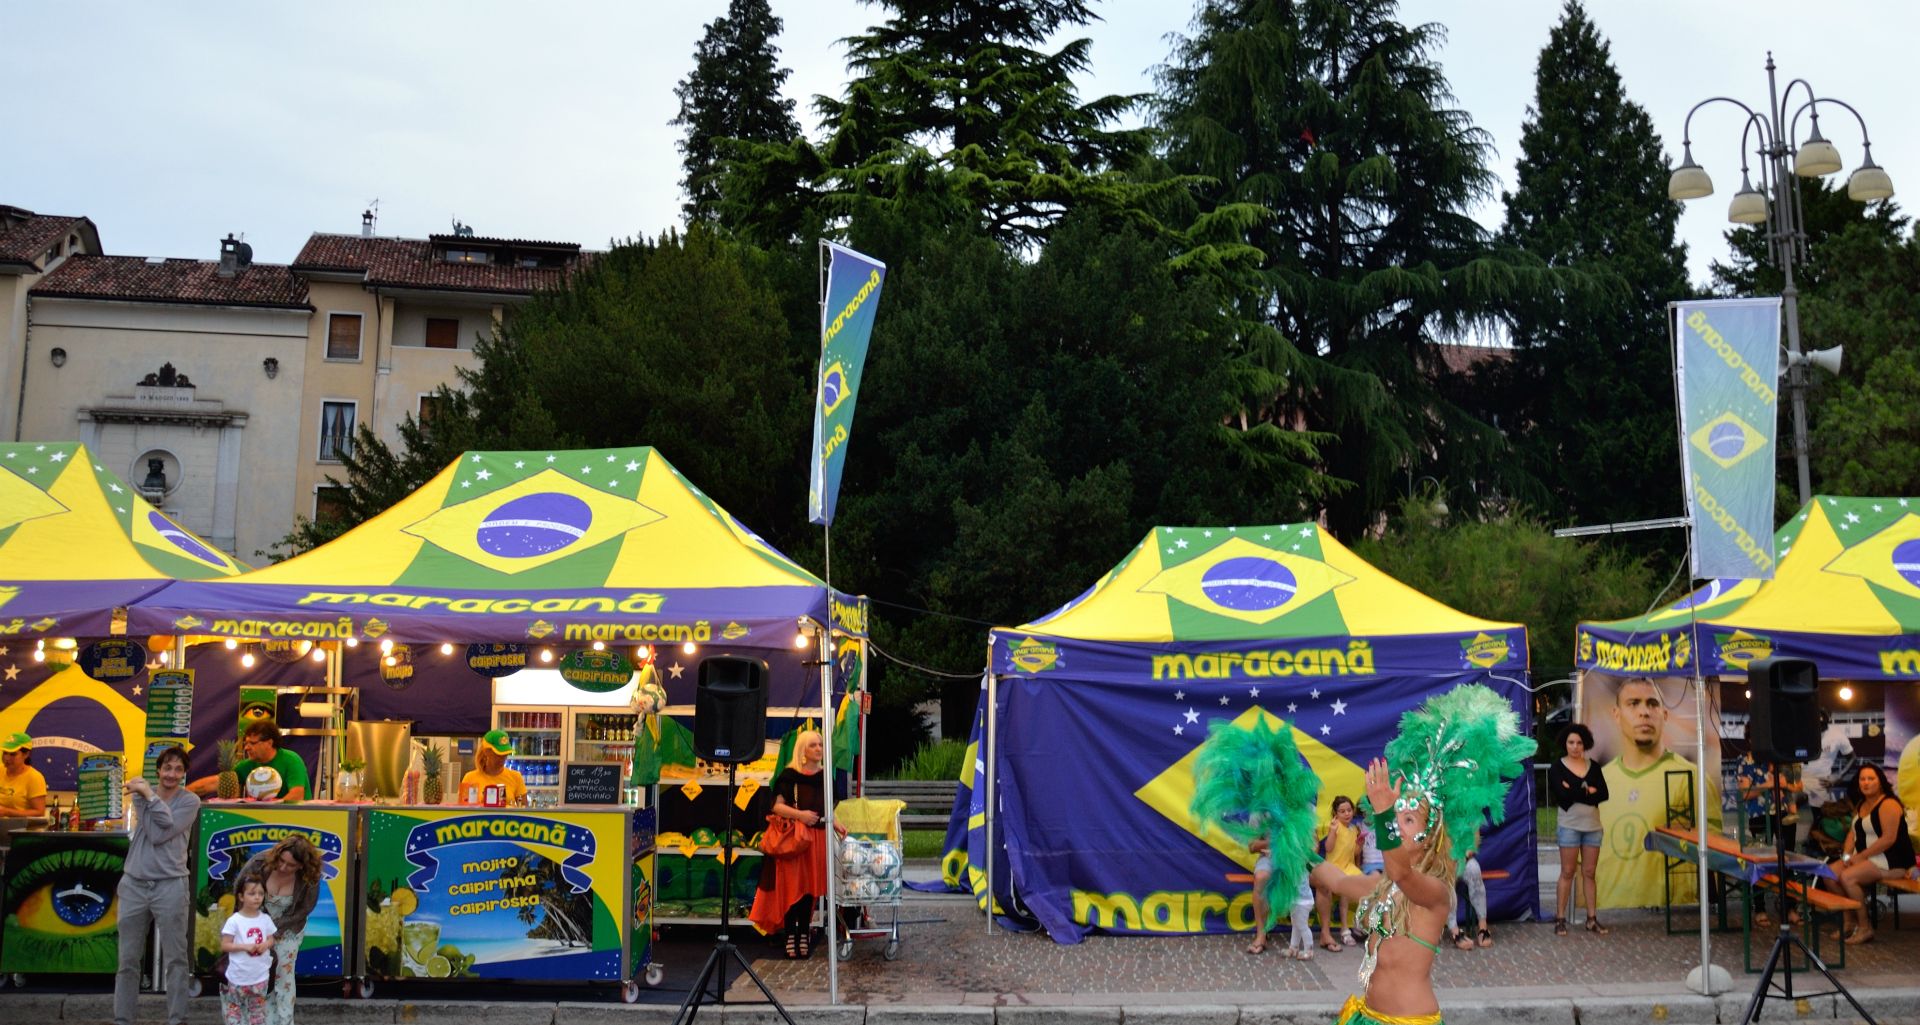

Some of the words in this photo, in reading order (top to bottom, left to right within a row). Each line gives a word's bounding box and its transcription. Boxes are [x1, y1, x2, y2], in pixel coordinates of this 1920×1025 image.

[297, 592, 668, 614] maracanã
[212, 617, 353, 638] maracanã
[565, 620, 711, 642] maracanã
[469, 653, 526, 669] caipiroska
[1152, 640, 1376, 680] maracanã
[564, 668, 629, 684] caipirinha
[32, 738, 56, 746] RDEM
[435, 819, 567, 847] maracanã
[462, 857, 518, 874] mojito
[448, 874, 537, 896] caipirinha
[449, 894, 540, 916] caipiroska
